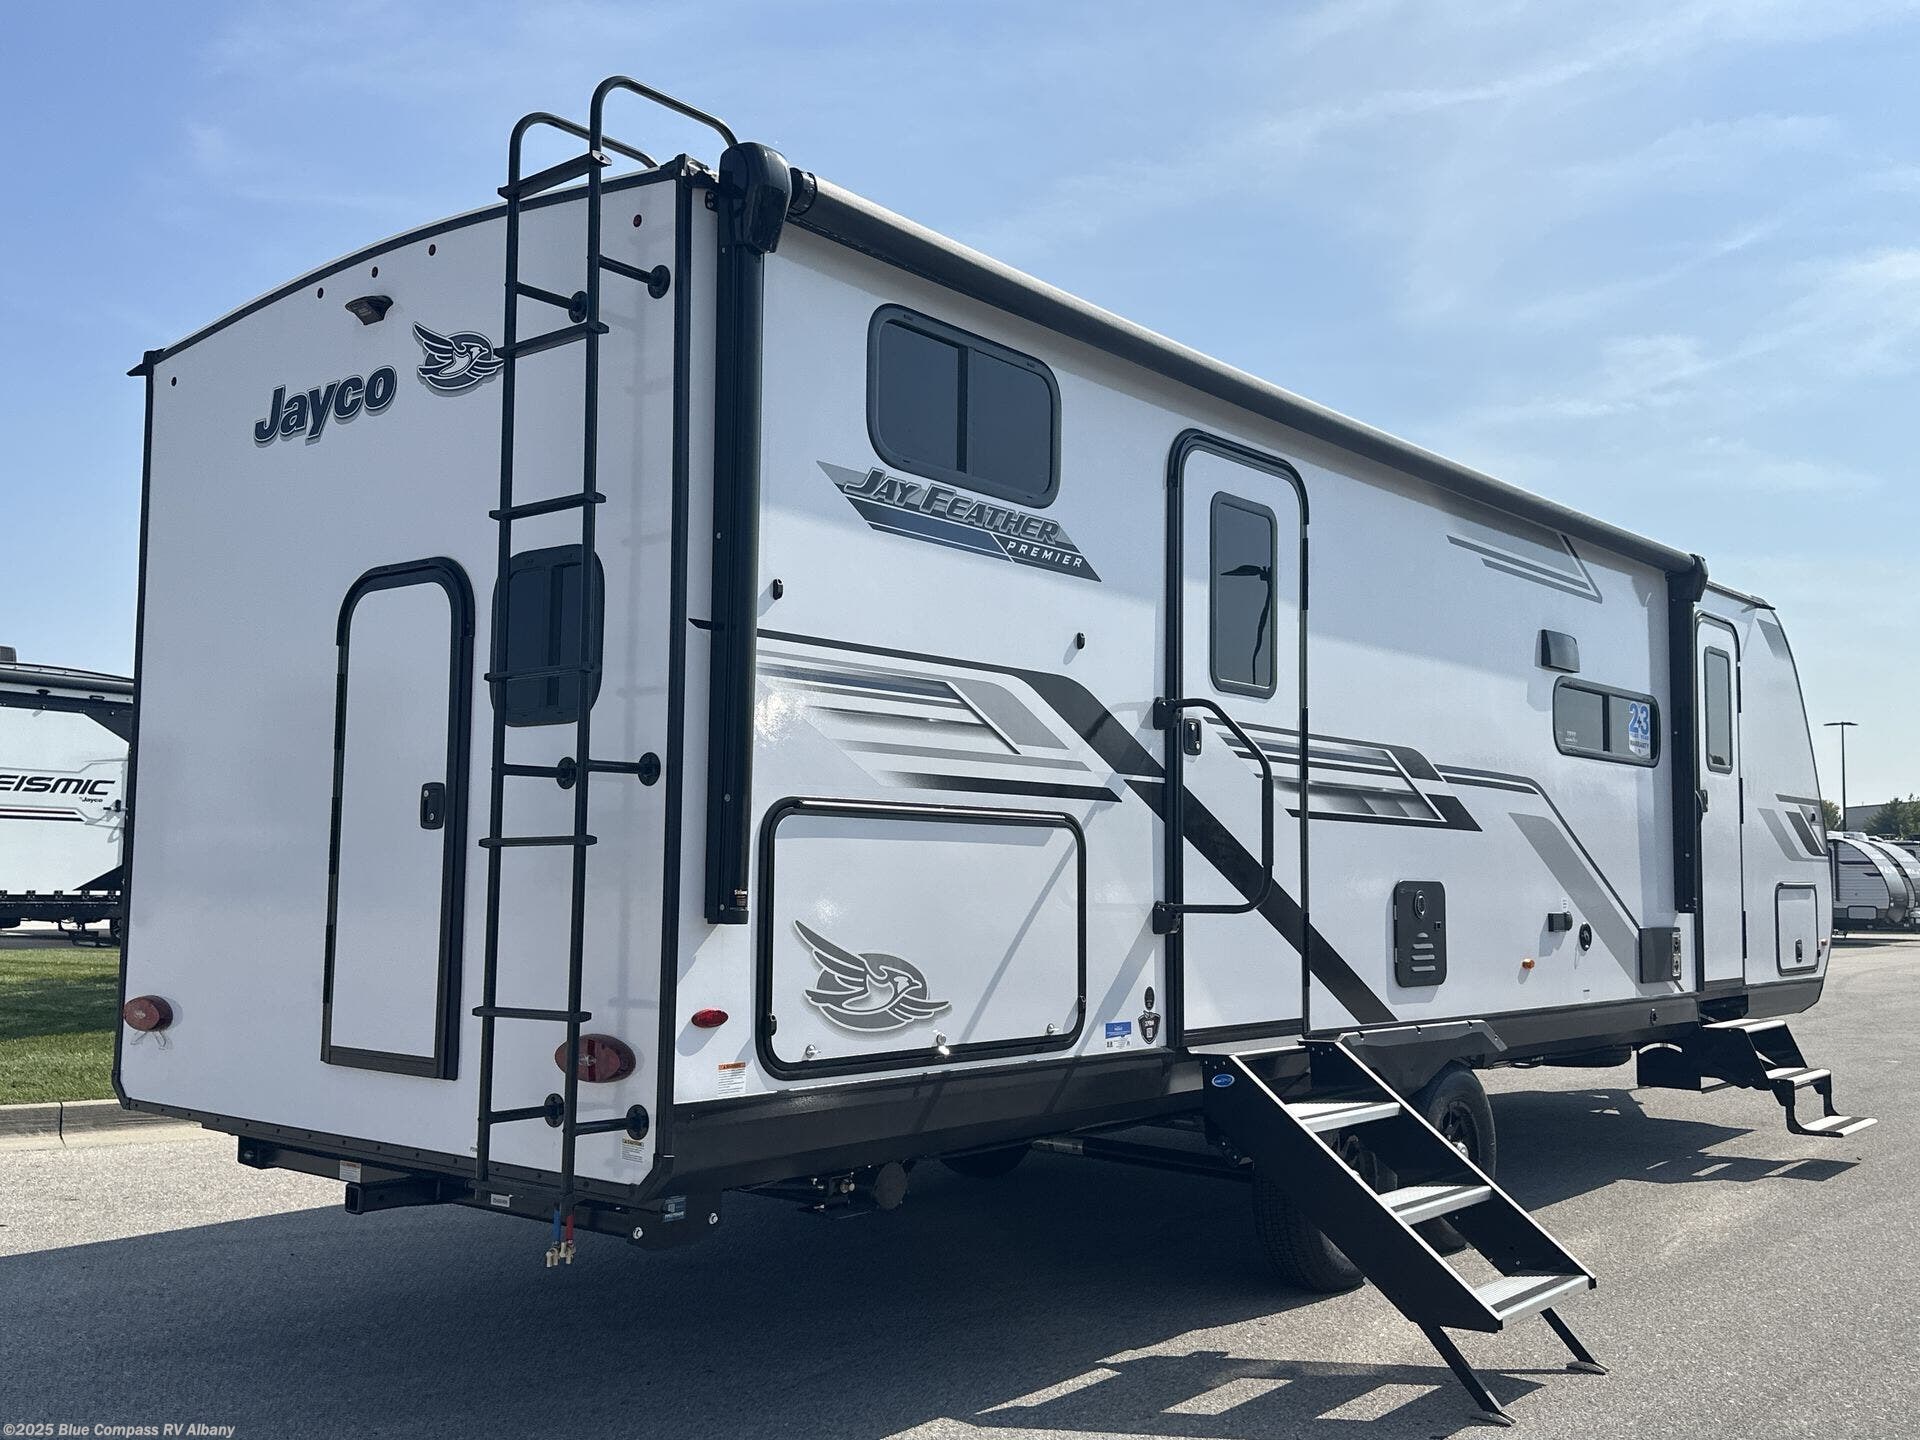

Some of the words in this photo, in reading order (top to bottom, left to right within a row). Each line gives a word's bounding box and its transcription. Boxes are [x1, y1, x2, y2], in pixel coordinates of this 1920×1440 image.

[253, 365, 397, 442] Jayco
[843, 467, 921, 503] JAY
[919, 483, 1061, 545] FEATHER
[1006, 540, 1083, 568] PREMIER
[0, 774, 116, 795] EISMIC
